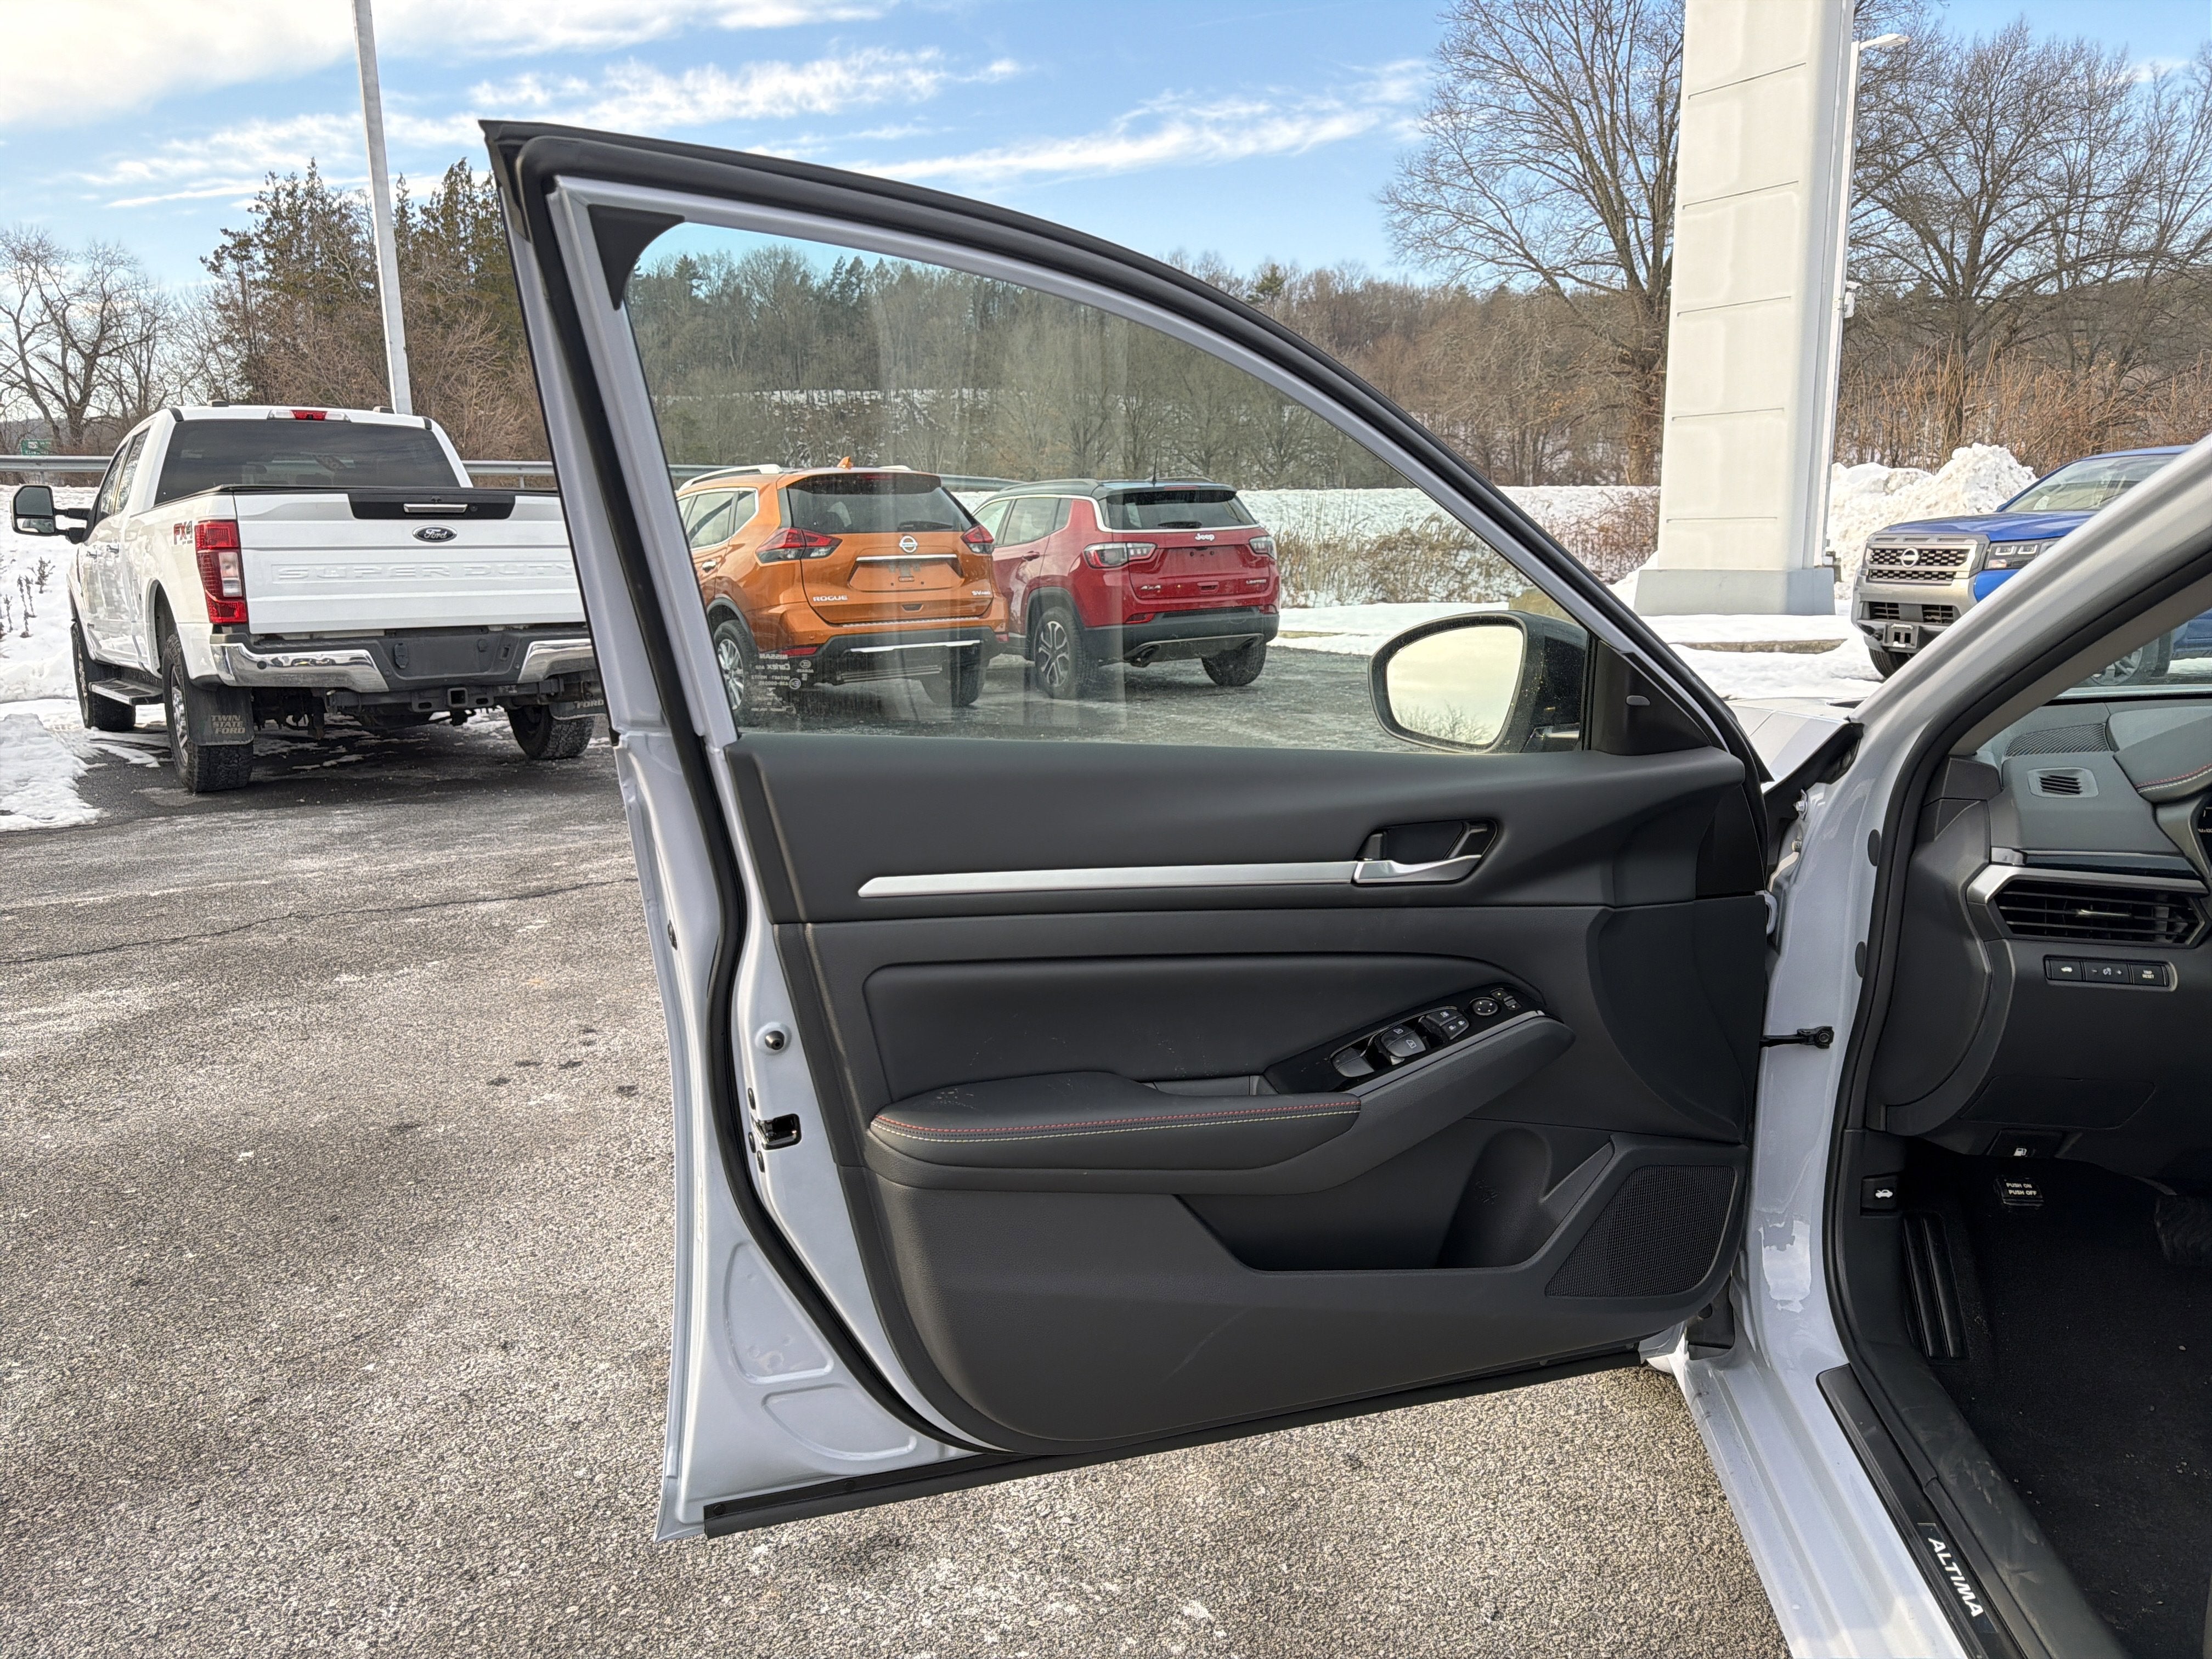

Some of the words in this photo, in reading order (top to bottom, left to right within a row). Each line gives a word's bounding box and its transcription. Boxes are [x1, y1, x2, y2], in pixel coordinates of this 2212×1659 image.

[174, 521, 193, 545] FX4
[424, 528, 448, 539] Ford
[1195, 533, 1215, 541] Jeep
[278, 565, 450, 580] SUPER
[464, 563, 573, 576] DUTY
[573, 698, 604, 708] FORD
[1928, 1537, 1984, 1617] ALTIMA
